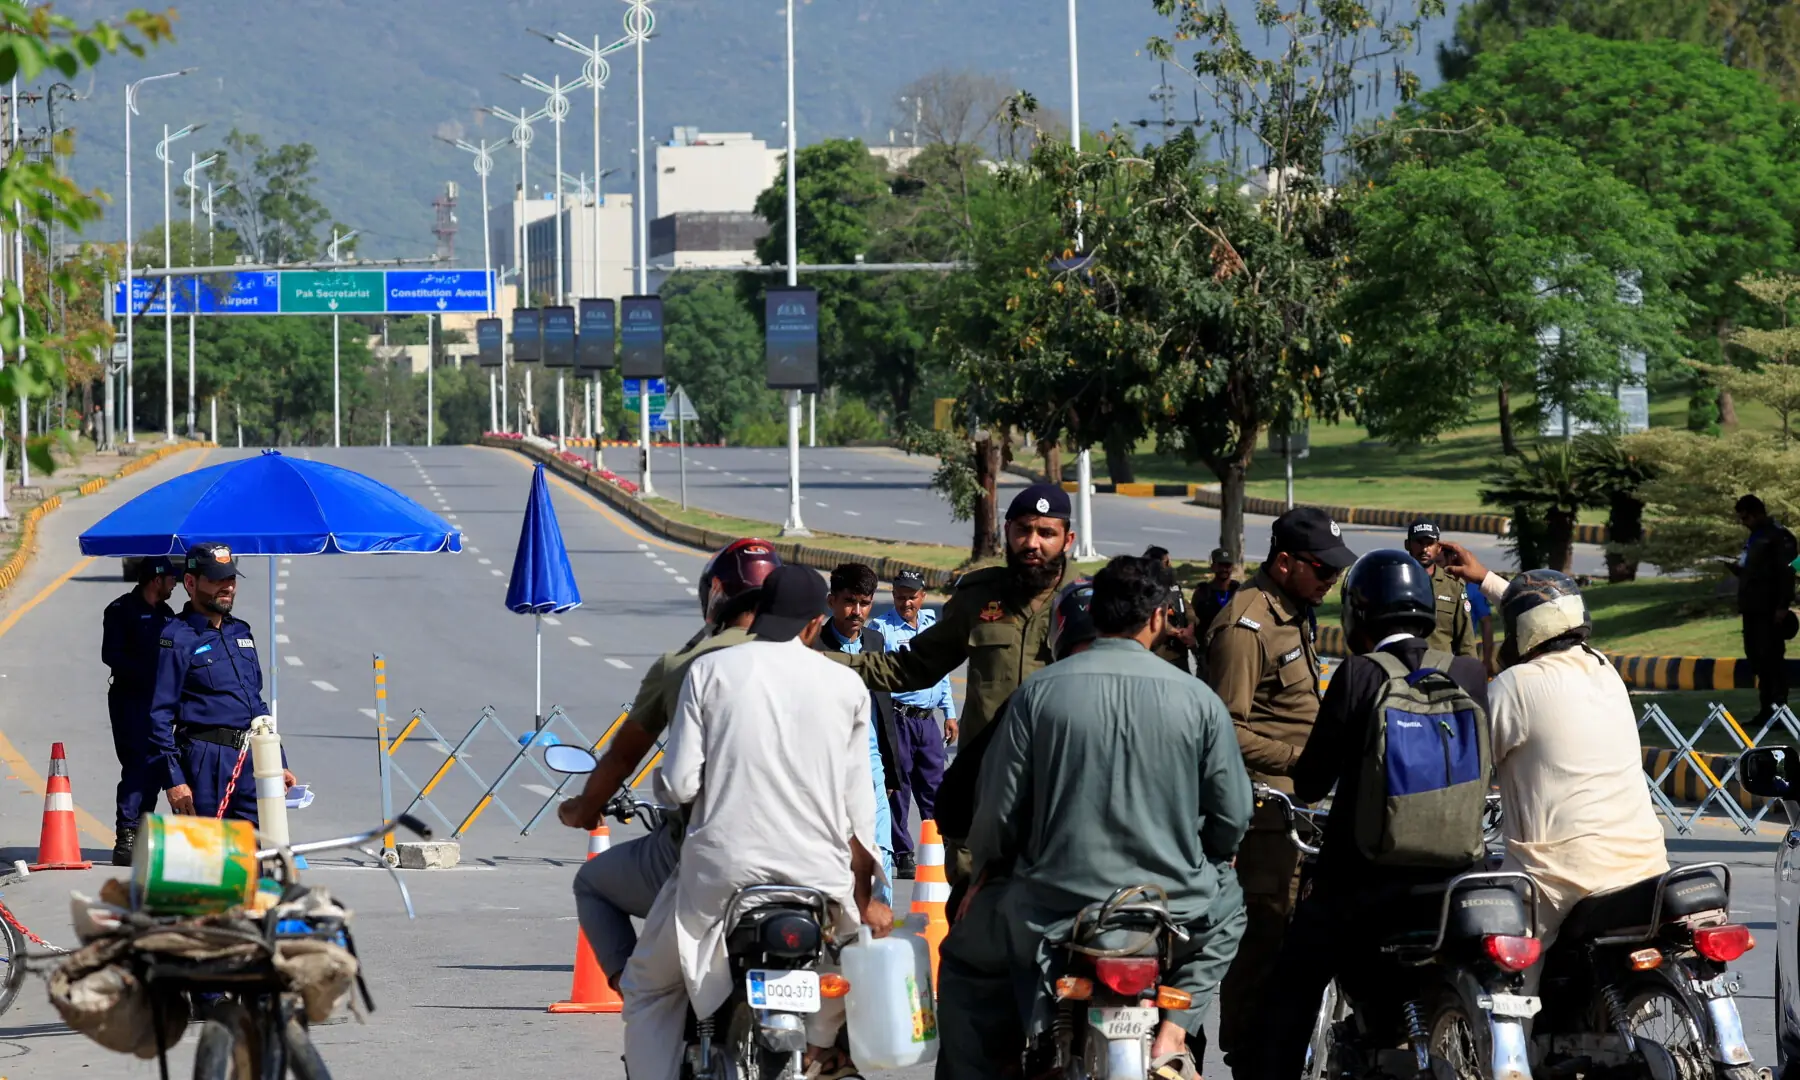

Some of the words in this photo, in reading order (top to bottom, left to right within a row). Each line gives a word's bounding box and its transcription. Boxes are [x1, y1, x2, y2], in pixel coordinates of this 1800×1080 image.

[295, 289, 313, 298] Pak
[316, 288, 370, 298] Secretariat
[391, 288, 452, 298] Constitution
[220, 296, 258, 307] Airport
[1413, 524, 1433, 532] POLICE
[1676, 882, 1717, 896] HONDA
[1461, 899, 1515, 908] HONDA
[1108, 1022, 1141, 1034] 1646
